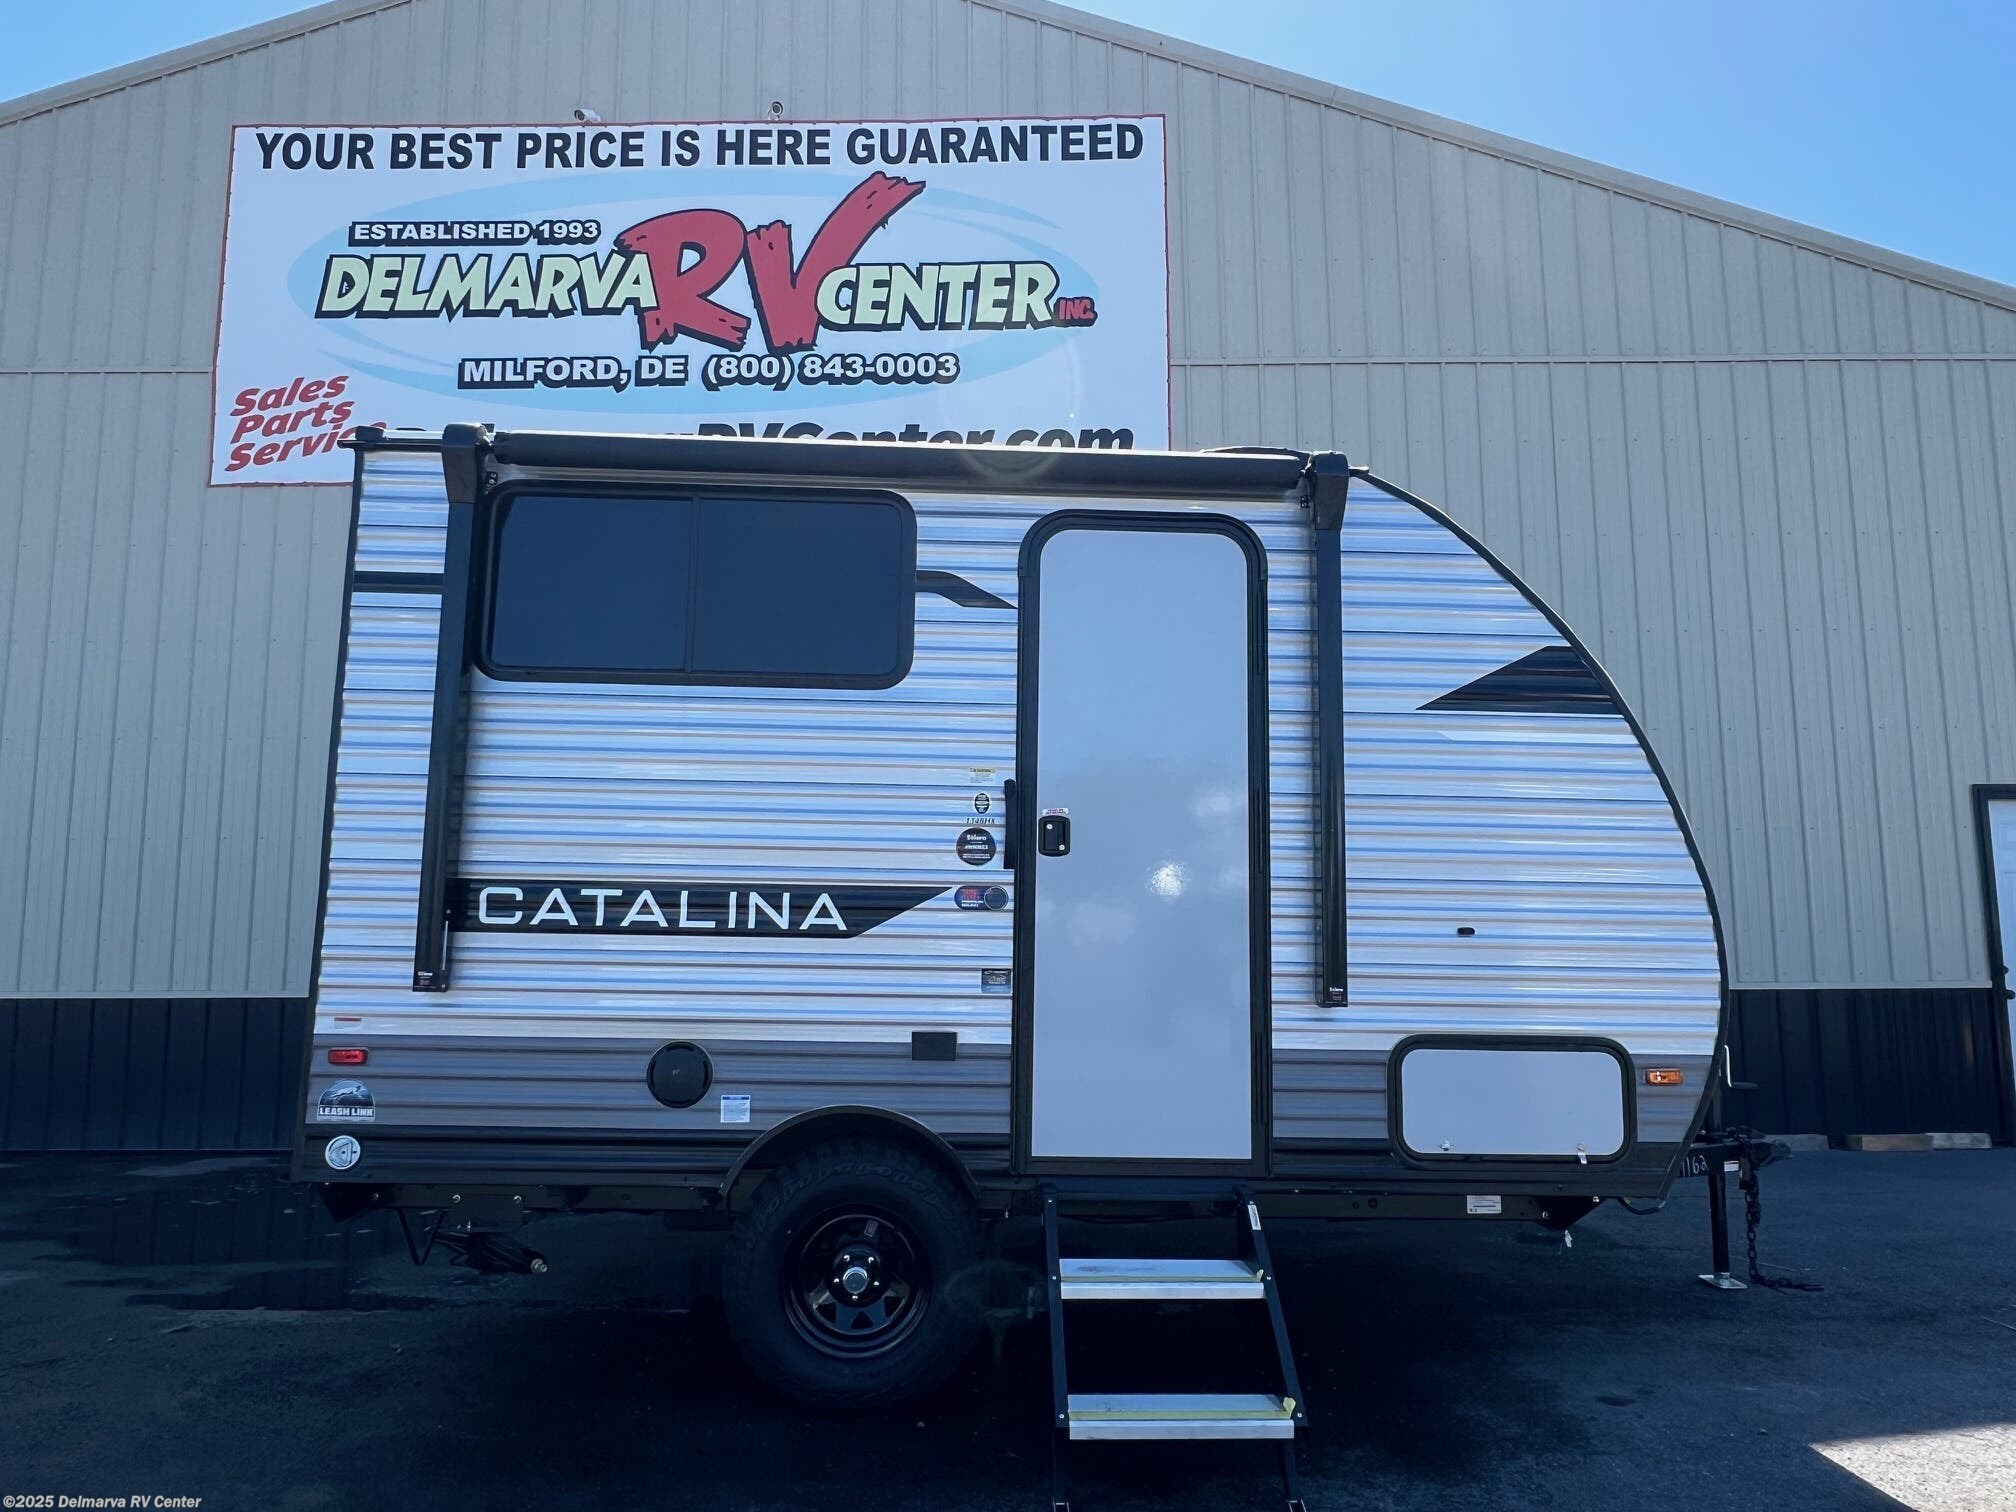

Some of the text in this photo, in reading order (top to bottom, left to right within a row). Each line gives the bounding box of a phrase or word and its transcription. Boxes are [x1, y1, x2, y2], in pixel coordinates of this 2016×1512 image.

[256, 123, 1144, 170] YOUR BEST PRICE IS HERE GUARANTEED
[352, 221, 600, 242] ESTABLISHED 1993
[316, 252, 657, 321] DELMARVA
[615, 172, 925, 351] RV
[816, 261, 1059, 329] CENTER
[463, 354, 958, 388] MILFORD, DE (800) 843-0003
[230, 375, 348, 416] Sales
[231, 400, 354, 444] Parts
[225, 422, 387, 472] Servi
[478, 886, 848, 931] CATALINA
[319, 1106, 374, 1117] LEASH LINK
